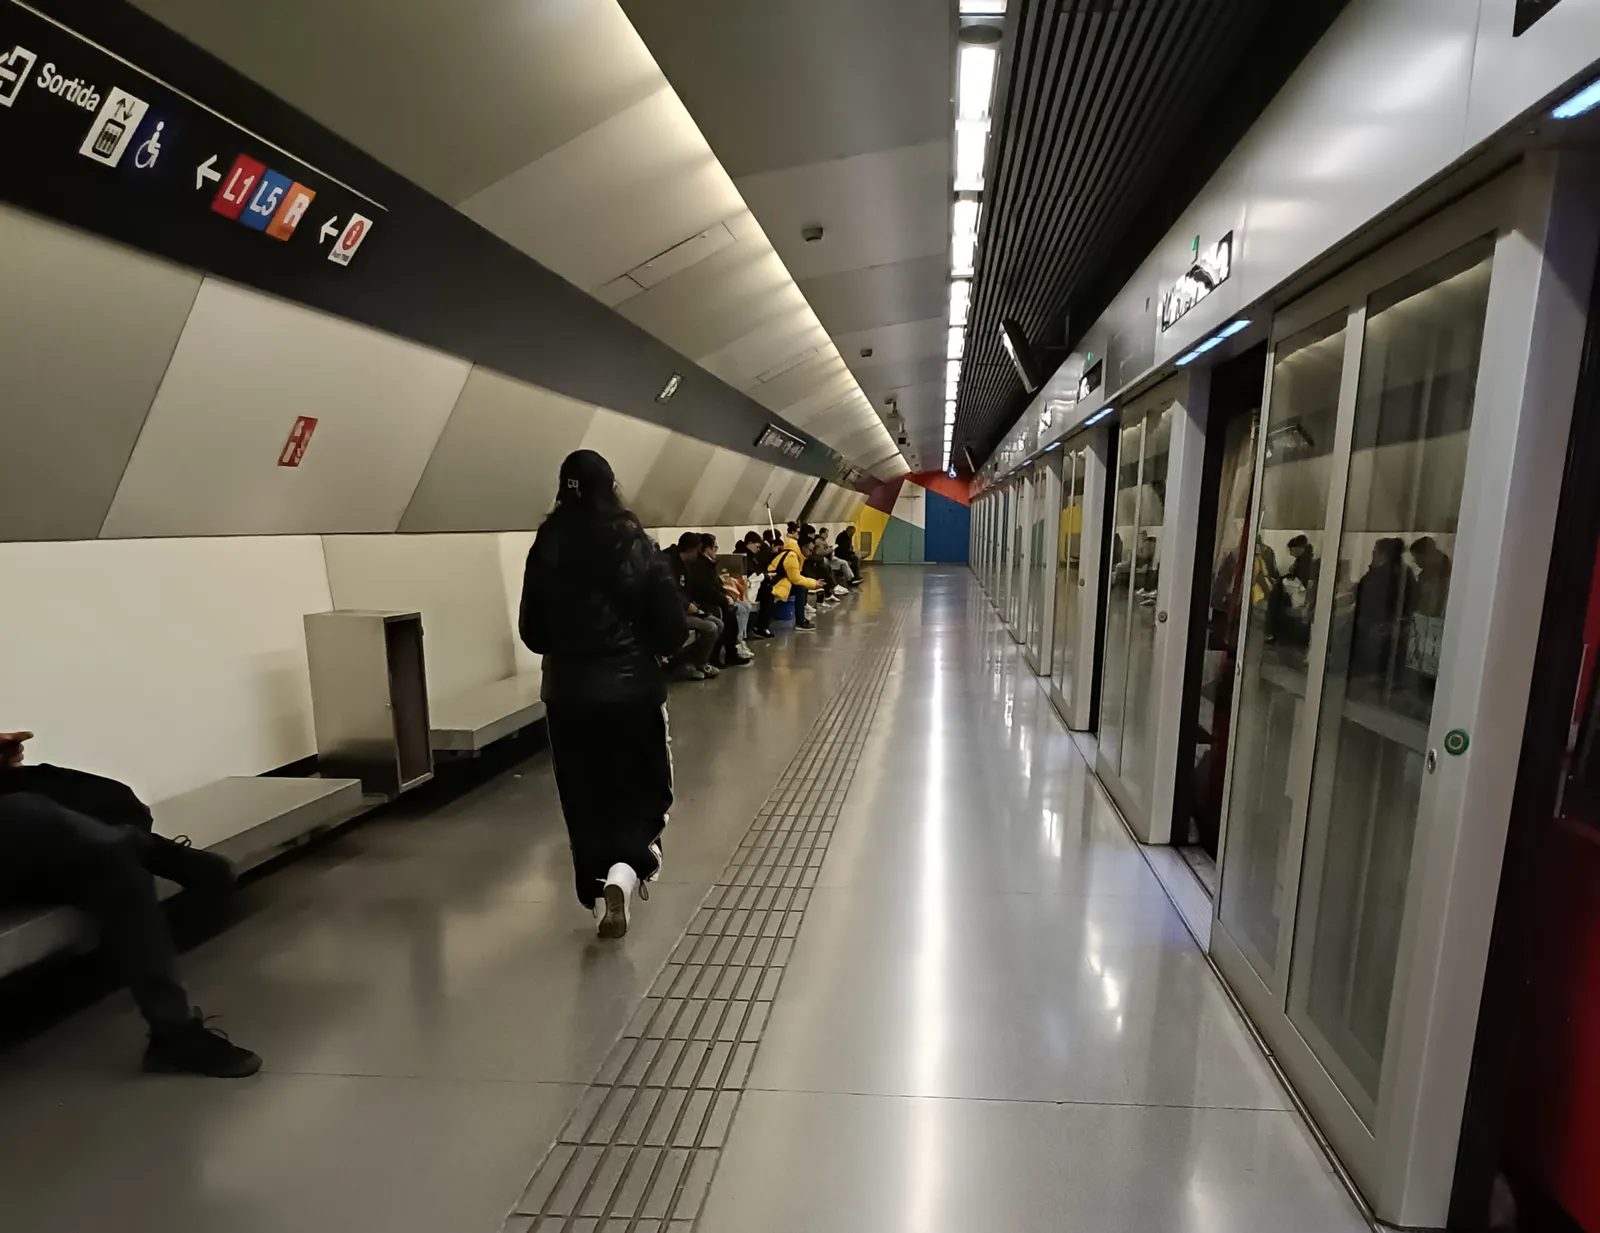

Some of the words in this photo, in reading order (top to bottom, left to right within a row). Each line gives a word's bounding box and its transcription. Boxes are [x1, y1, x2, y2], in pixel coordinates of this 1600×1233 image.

[37, 62, 100, 112] Sortida
[223, 167, 255, 204] L1
[250, 180, 283, 216] L5
[283, 193, 310, 228] R
